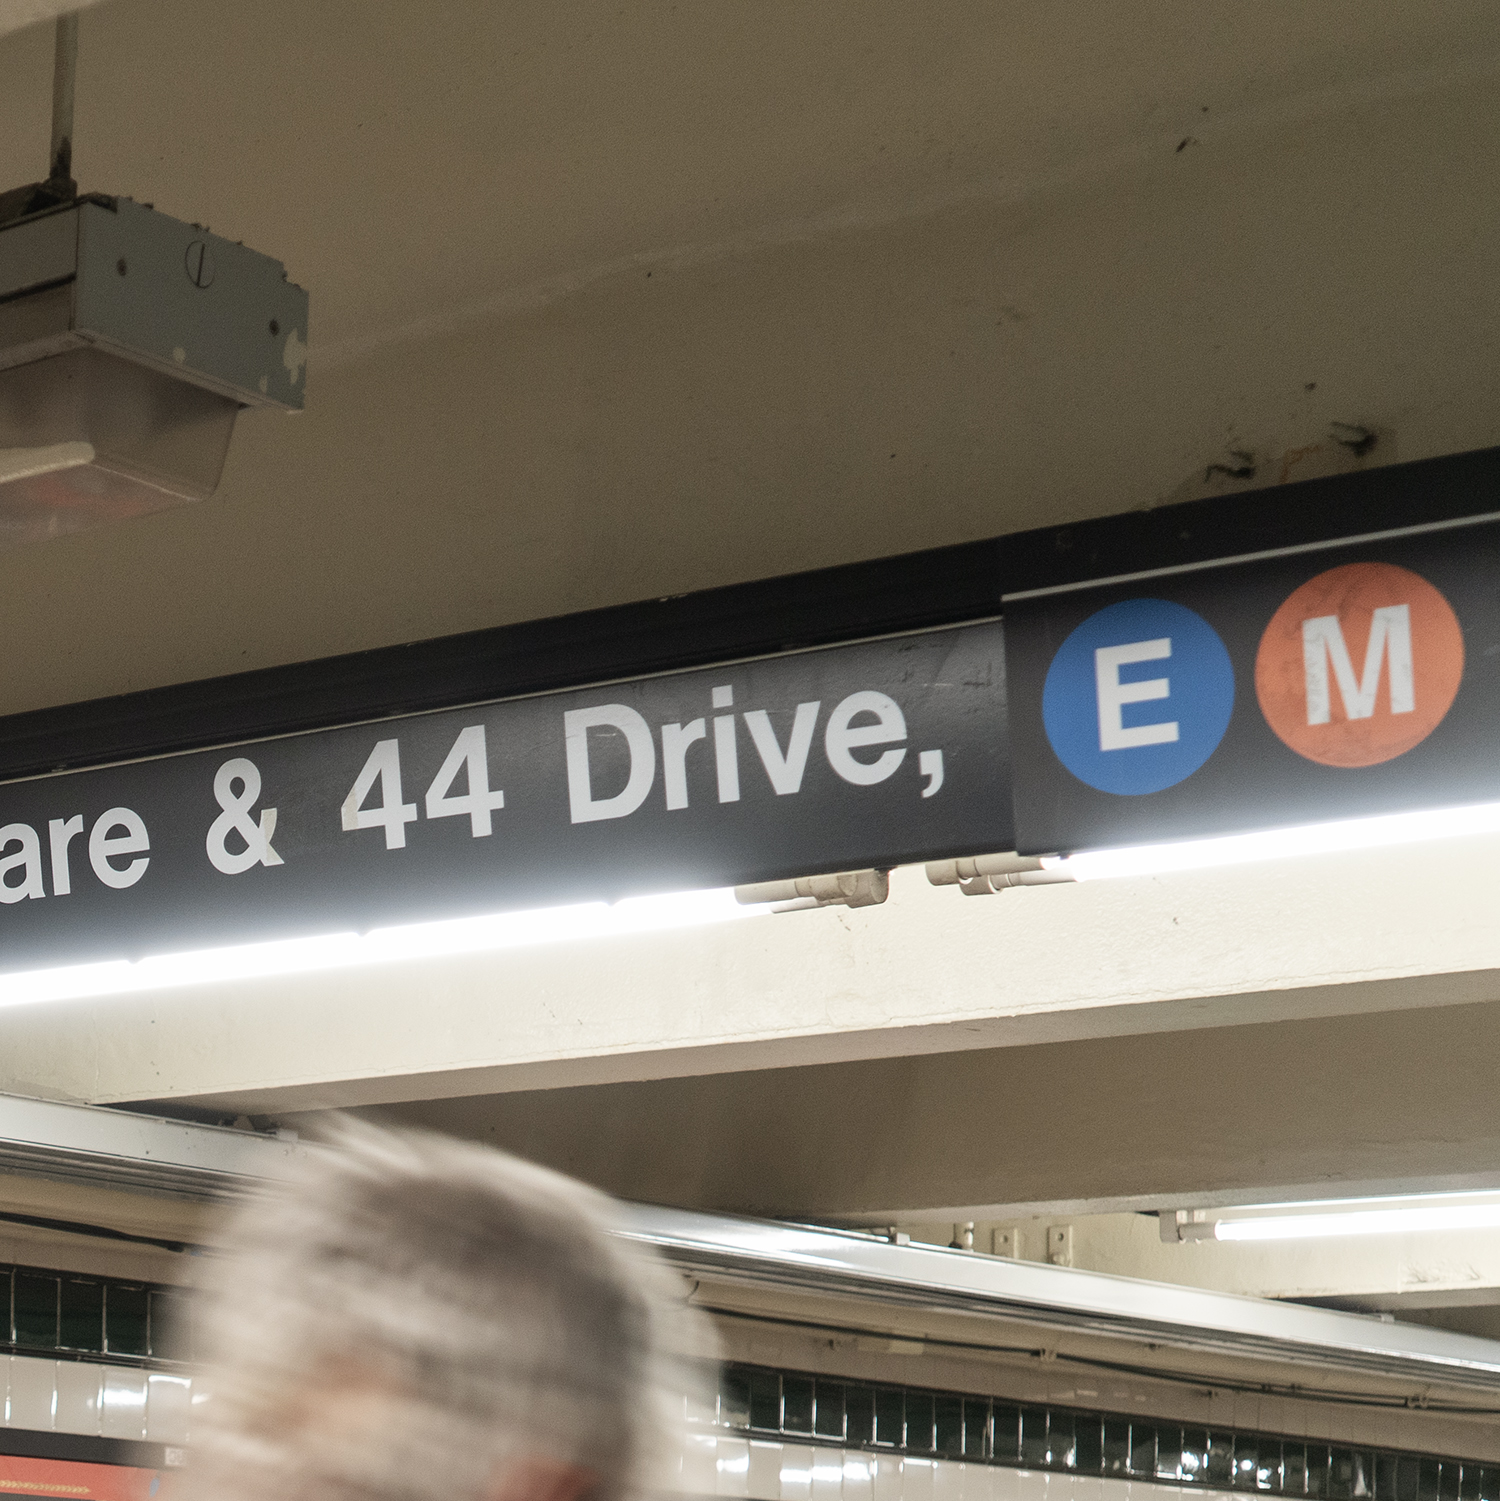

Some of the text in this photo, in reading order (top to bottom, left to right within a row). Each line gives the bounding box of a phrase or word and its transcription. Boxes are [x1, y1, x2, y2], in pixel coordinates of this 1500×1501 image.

[1095, 604, 1415, 752] E M
[205, 757, 284, 875] &
[341, 725, 504, 849] 44
[564, 686, 945, 826] Drive,
